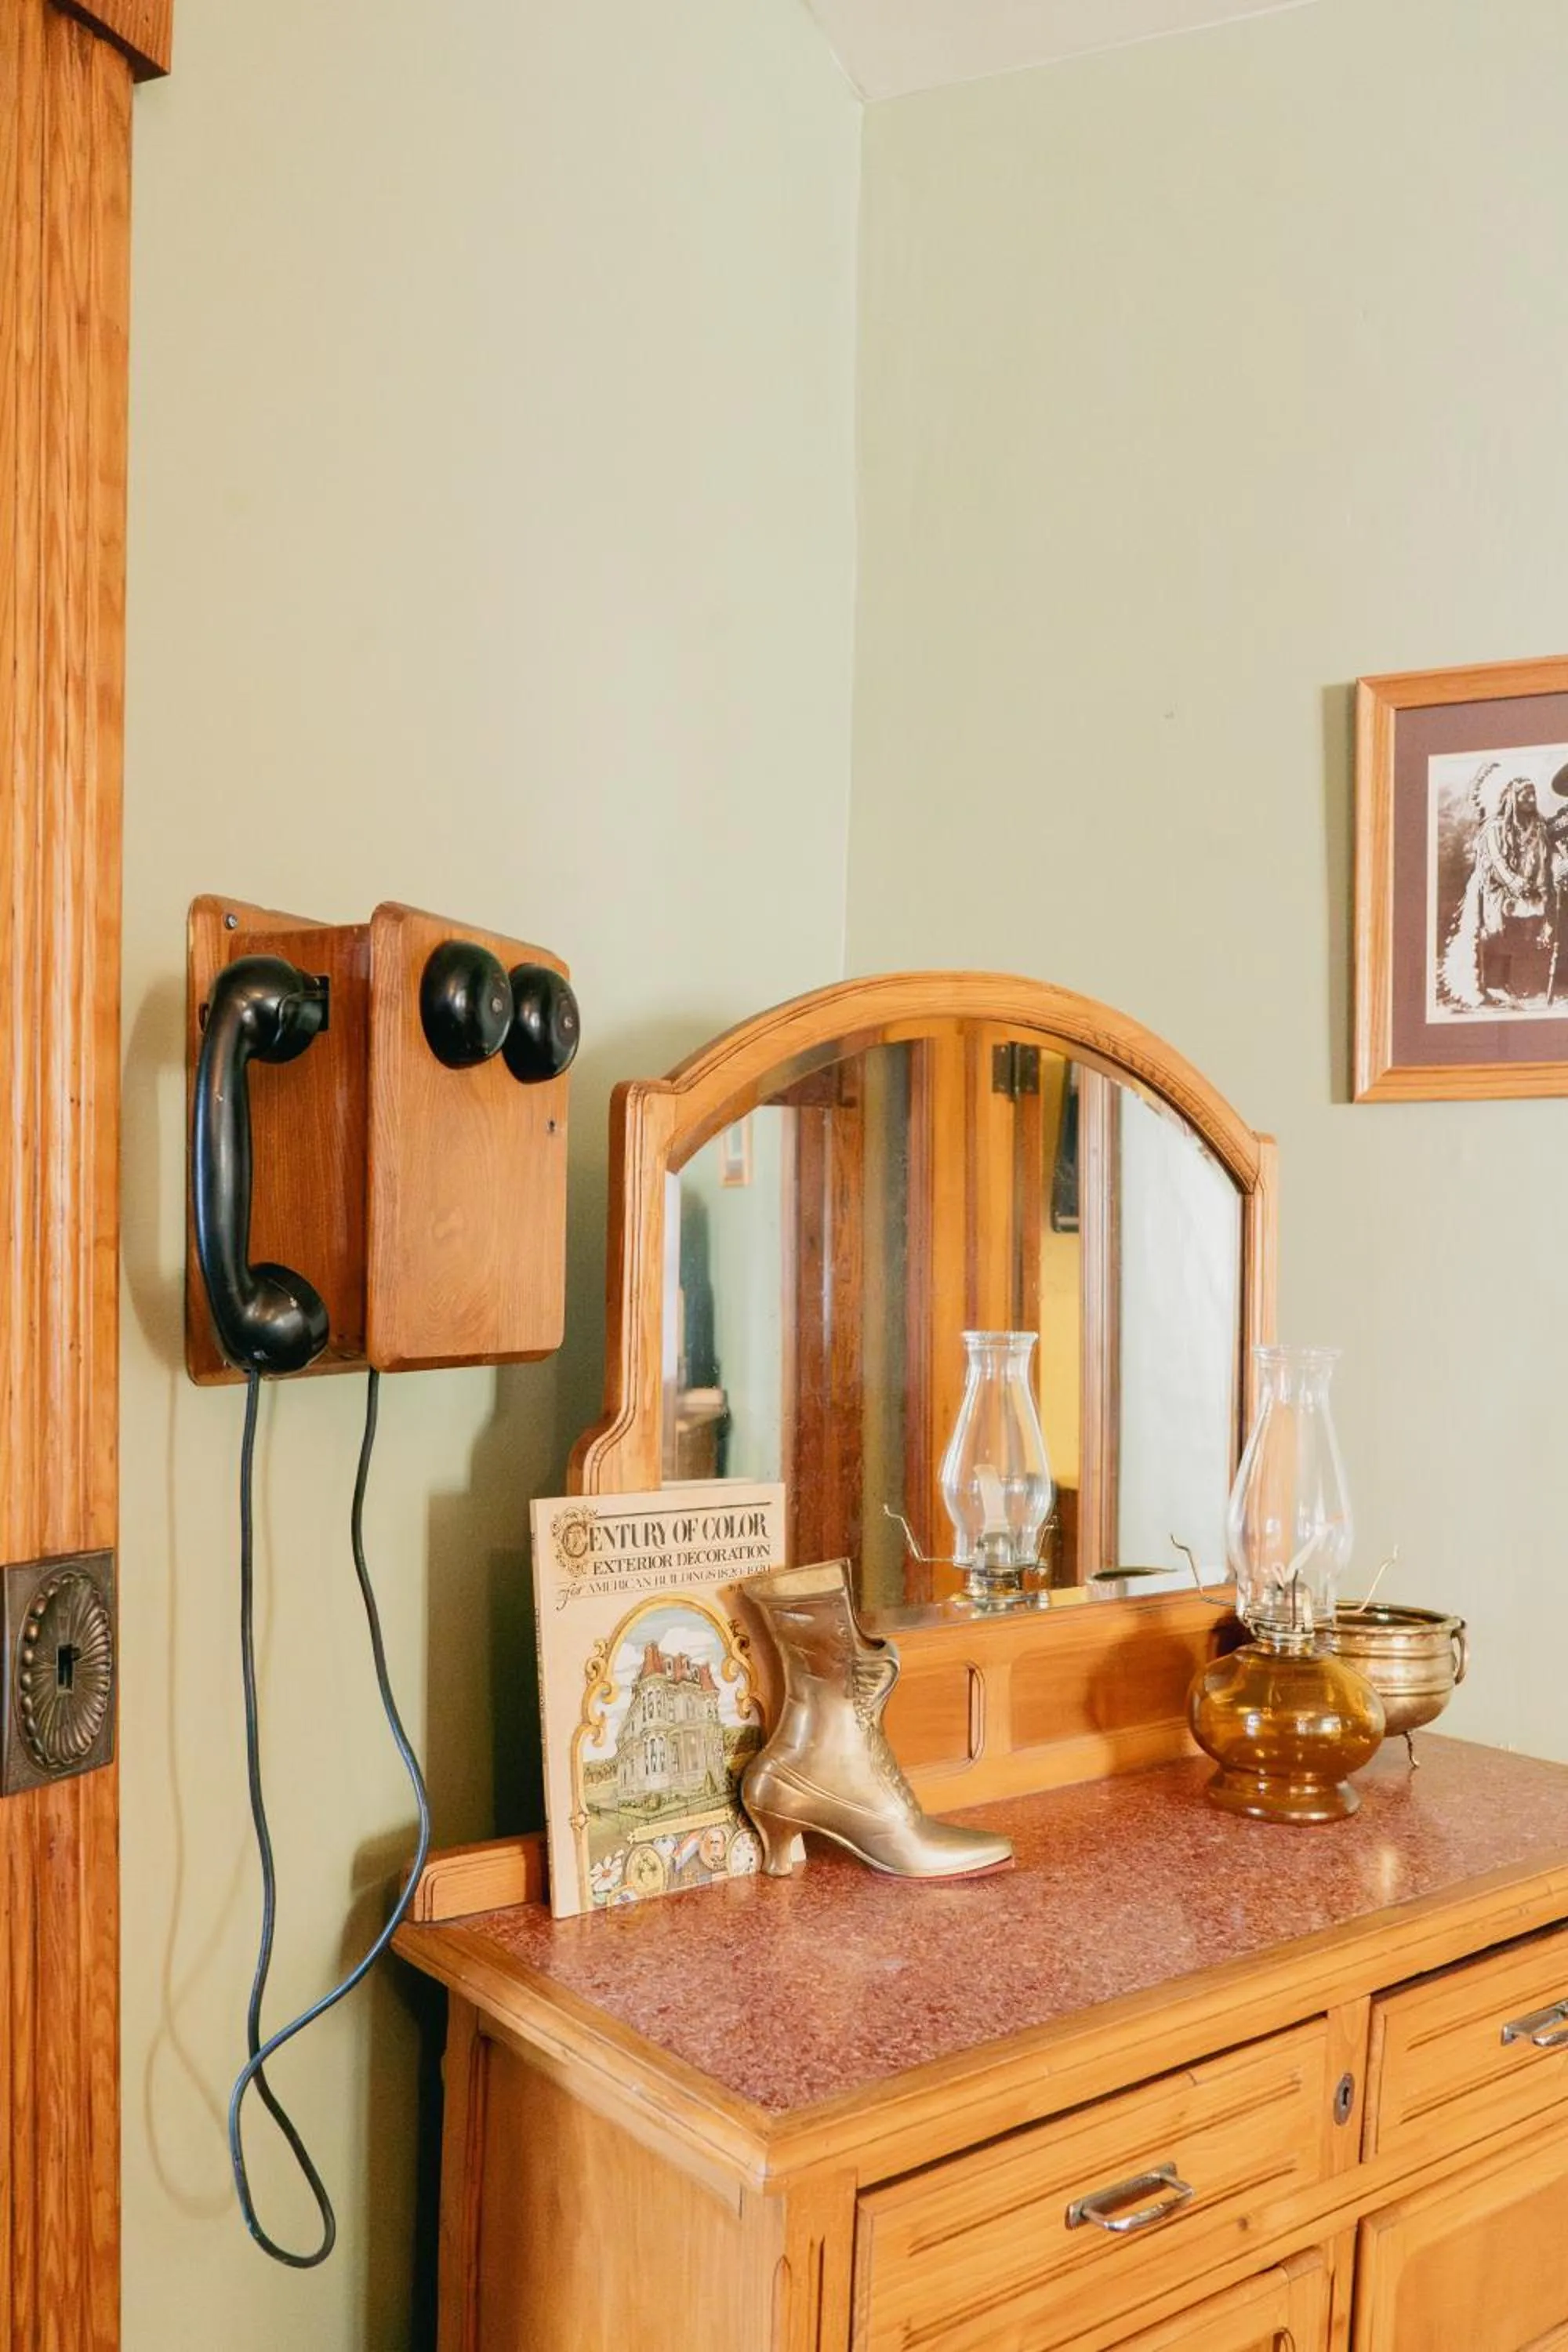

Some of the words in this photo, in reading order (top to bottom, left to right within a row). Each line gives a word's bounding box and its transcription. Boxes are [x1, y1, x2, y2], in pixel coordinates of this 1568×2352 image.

[563, 1522, 666, 1558] CENTURY
[673, 1518, 699, 1544] OF
[702, 1512, 769, 1539] COLOR
[593, 1555, 672, 1575] EXTERIOR
[677, 1544, 771, 1566] DECORATION
[556, 1583, 583, 1611] for
[588, 1577, 651, 1593] AMERICAN
[655, 1570, 715, 1586] BUILDINGS
